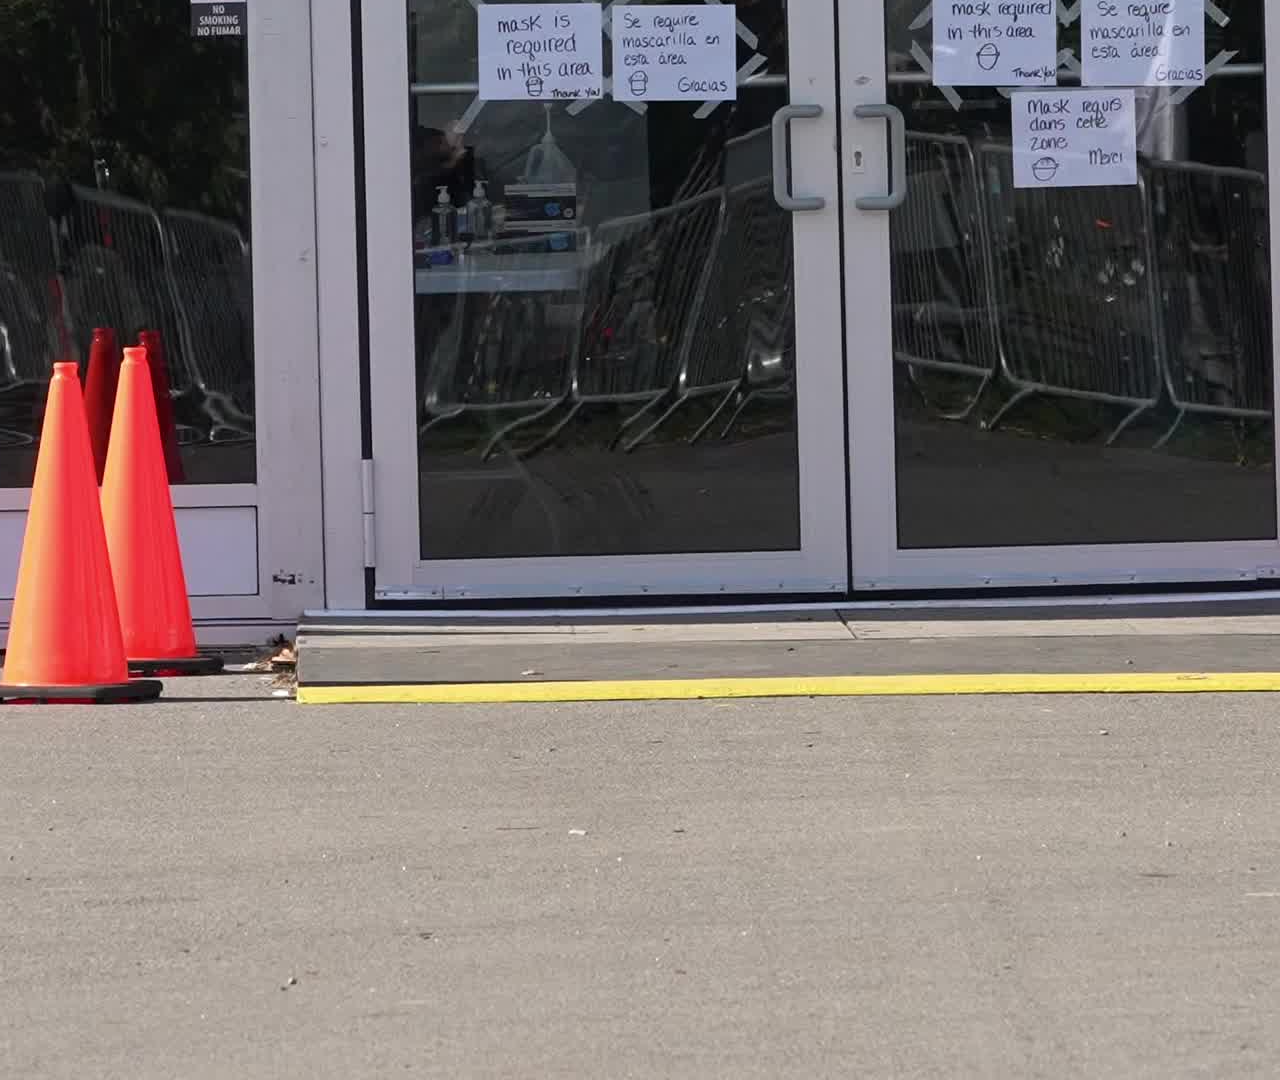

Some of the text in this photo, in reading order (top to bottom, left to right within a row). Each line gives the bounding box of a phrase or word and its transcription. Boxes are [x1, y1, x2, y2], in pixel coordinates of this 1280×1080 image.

[212, 5, 225, 14] NO
[998, 0, 1052, 22] required
[1097, 0, 1118, 17] Se
[199, 15, 239, 25] SMOKING
[554, 11, 571, 28] is
[623, 12, 699, 32] Se require
[197, 25, 241, 36] NO FUMAR
[947, 23, 1036, 40] in this area
[1089, 23, 1191, 40] mascarilla en
[506, 33, 577, 61] required
[622, 32, 720, 48] mascarilla en
[623, 53, 649, 66] esta
[1091, 46, 1120, 59] esta
[497, 62, 593, 81] in this area
[1012, 67, 1041, 79] Thank
[1155, 63, 1203, 81] Gracias
[677, 76, 728, 93] Gracias
[1027, 99, 1071, 115] Mask
[1029, 118, 1066, 131] dans
